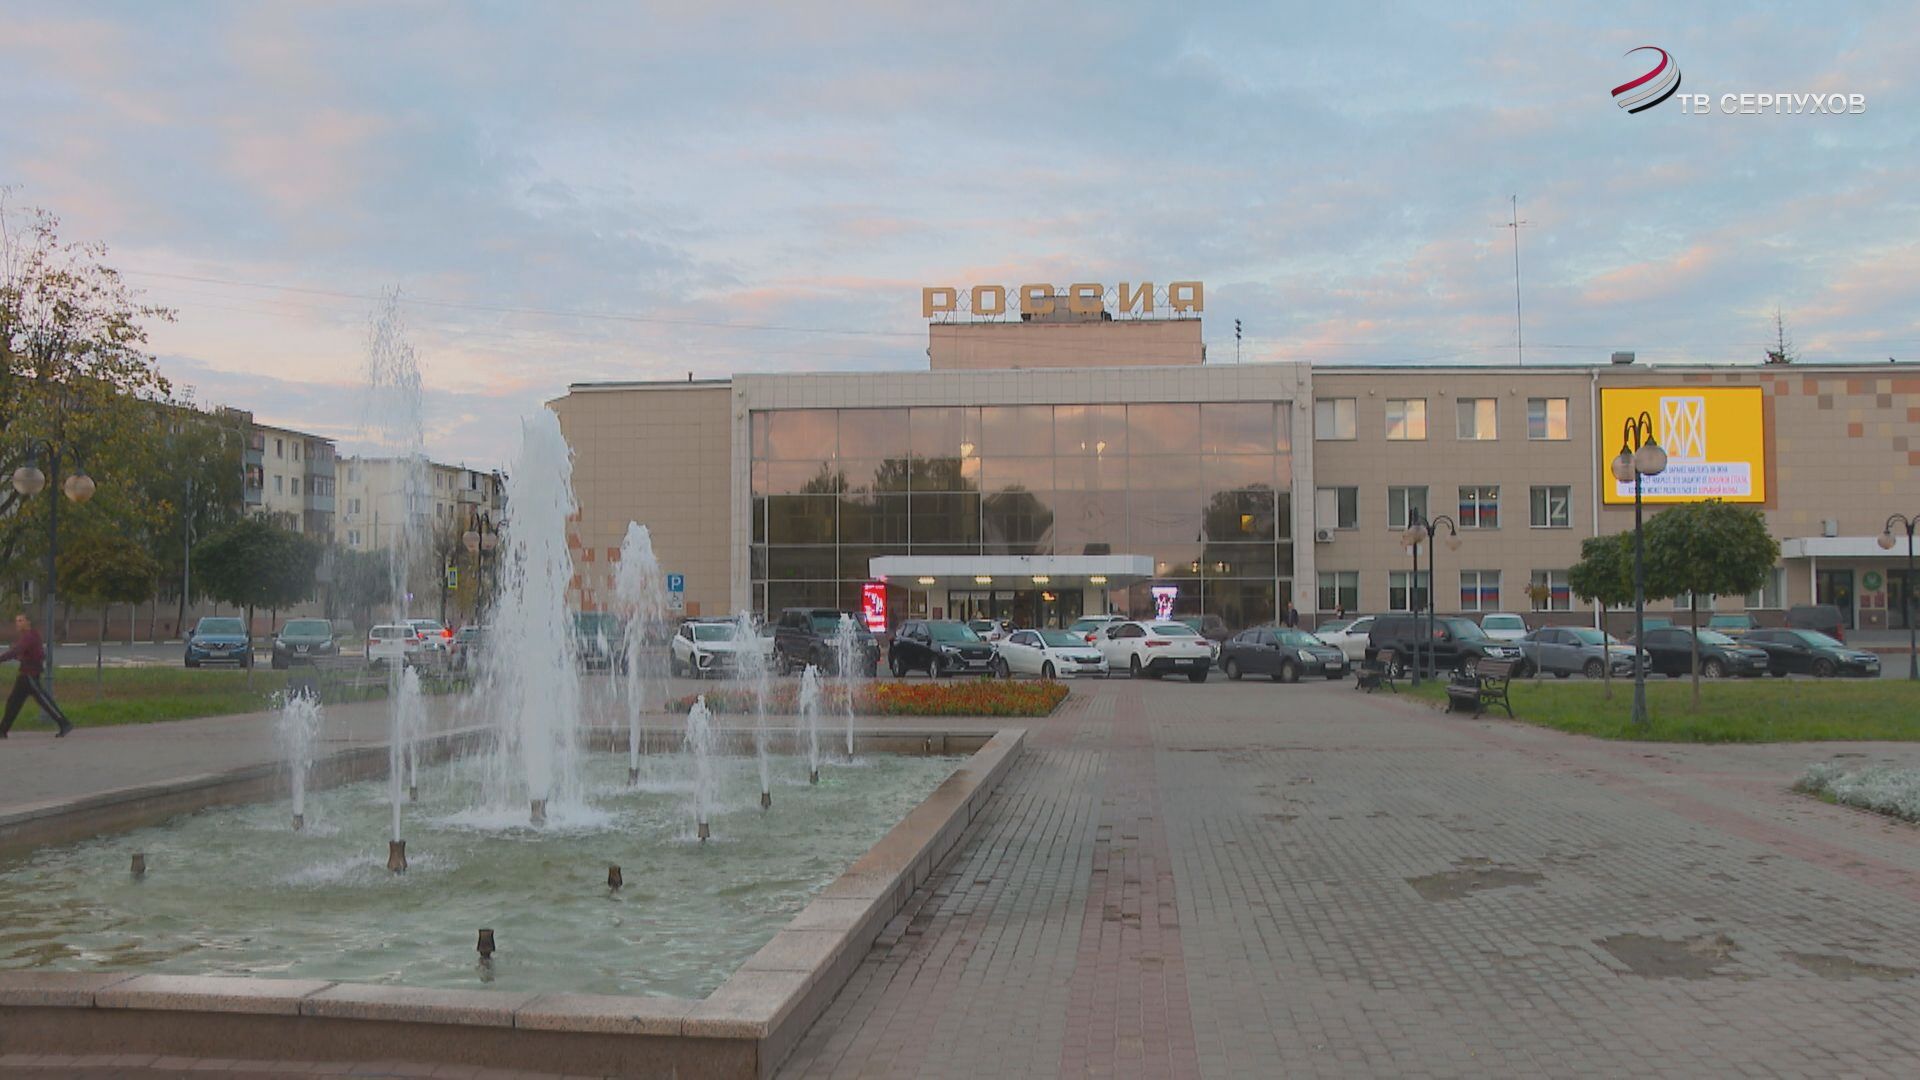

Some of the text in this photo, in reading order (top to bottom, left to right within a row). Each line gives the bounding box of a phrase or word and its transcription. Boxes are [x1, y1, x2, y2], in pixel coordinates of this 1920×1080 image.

[922, 281, 1203, 317] РОССИЯ
[1551, 497, 1566, 519] Z
[671, 576, 681, 591] P
